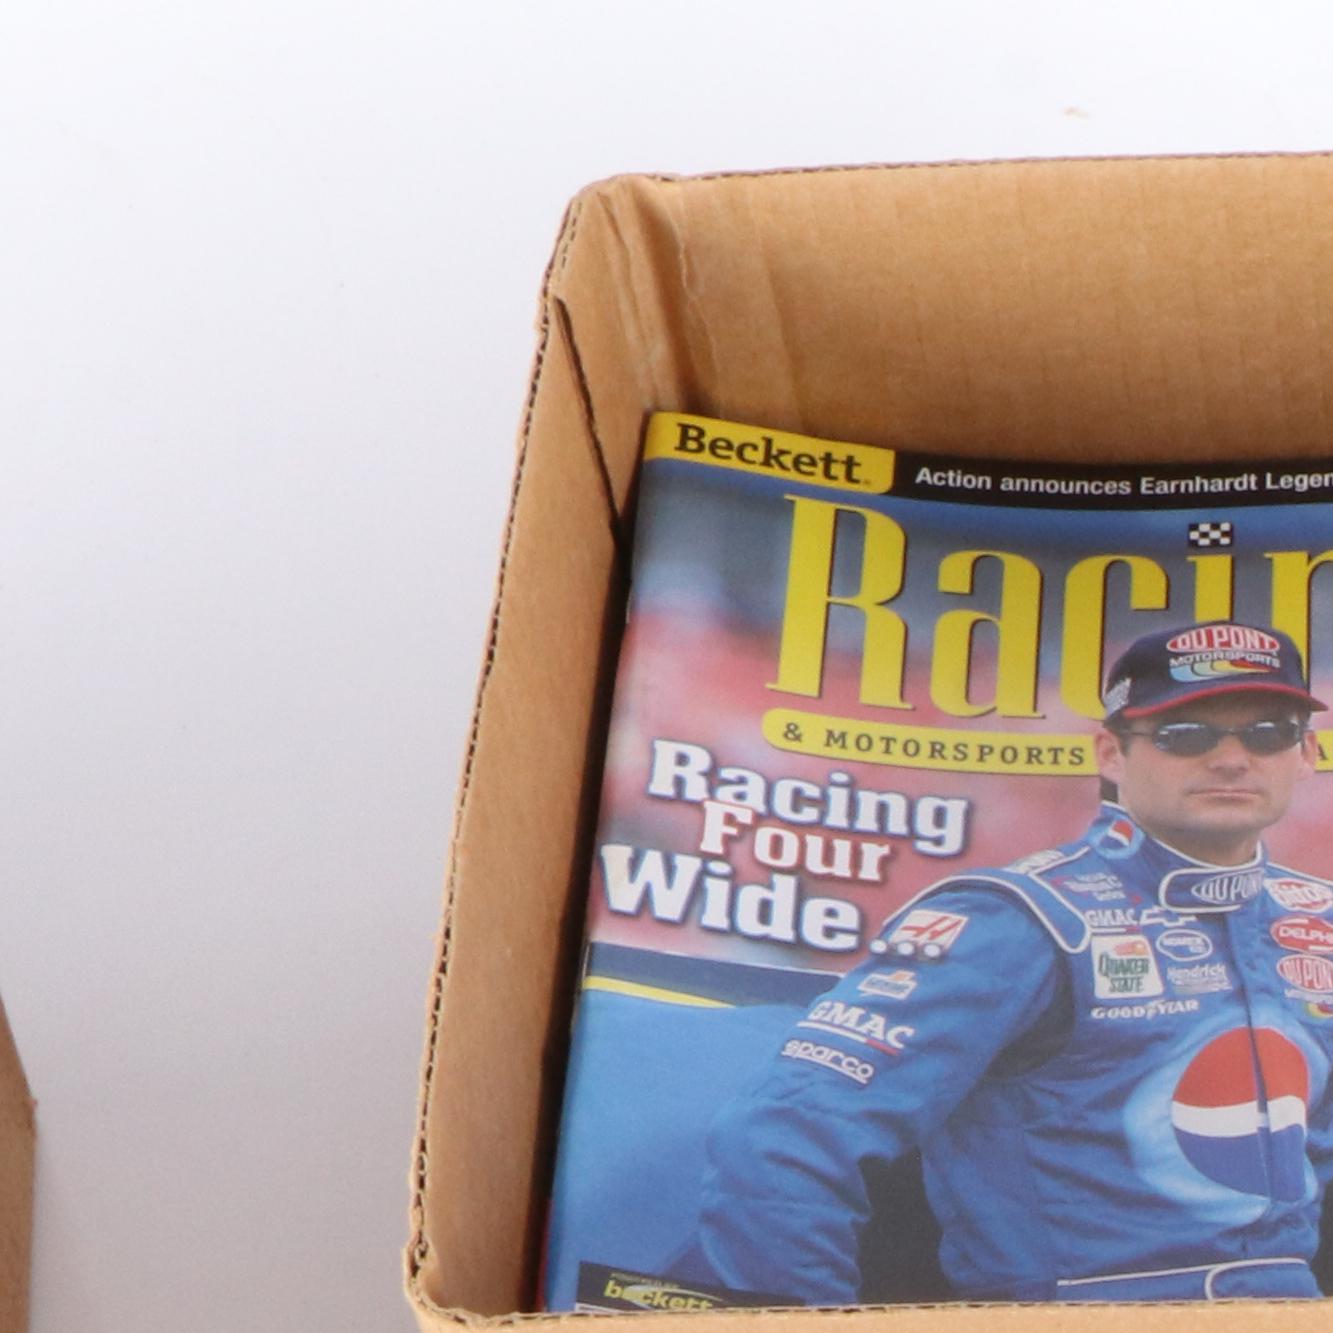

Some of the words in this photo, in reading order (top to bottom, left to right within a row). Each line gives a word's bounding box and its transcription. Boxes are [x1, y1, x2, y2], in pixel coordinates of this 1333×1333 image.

[675, 423, 861, 484] Beckett
[915, 467, 991, 491] Action
[1001, 476, 1131, 495] announces
[1140, 472, 1258, 496] Earnhardt
[783, 722, 802, 742] &
[825, 731, 1086, 767] MOTORSPORTS
[647, 738, 970, 858] Racing
[699, 800, 892, 882] Four
[808, 1000, 915, 1049] GMAC
[783, 1039, 874, 1080] sparco
